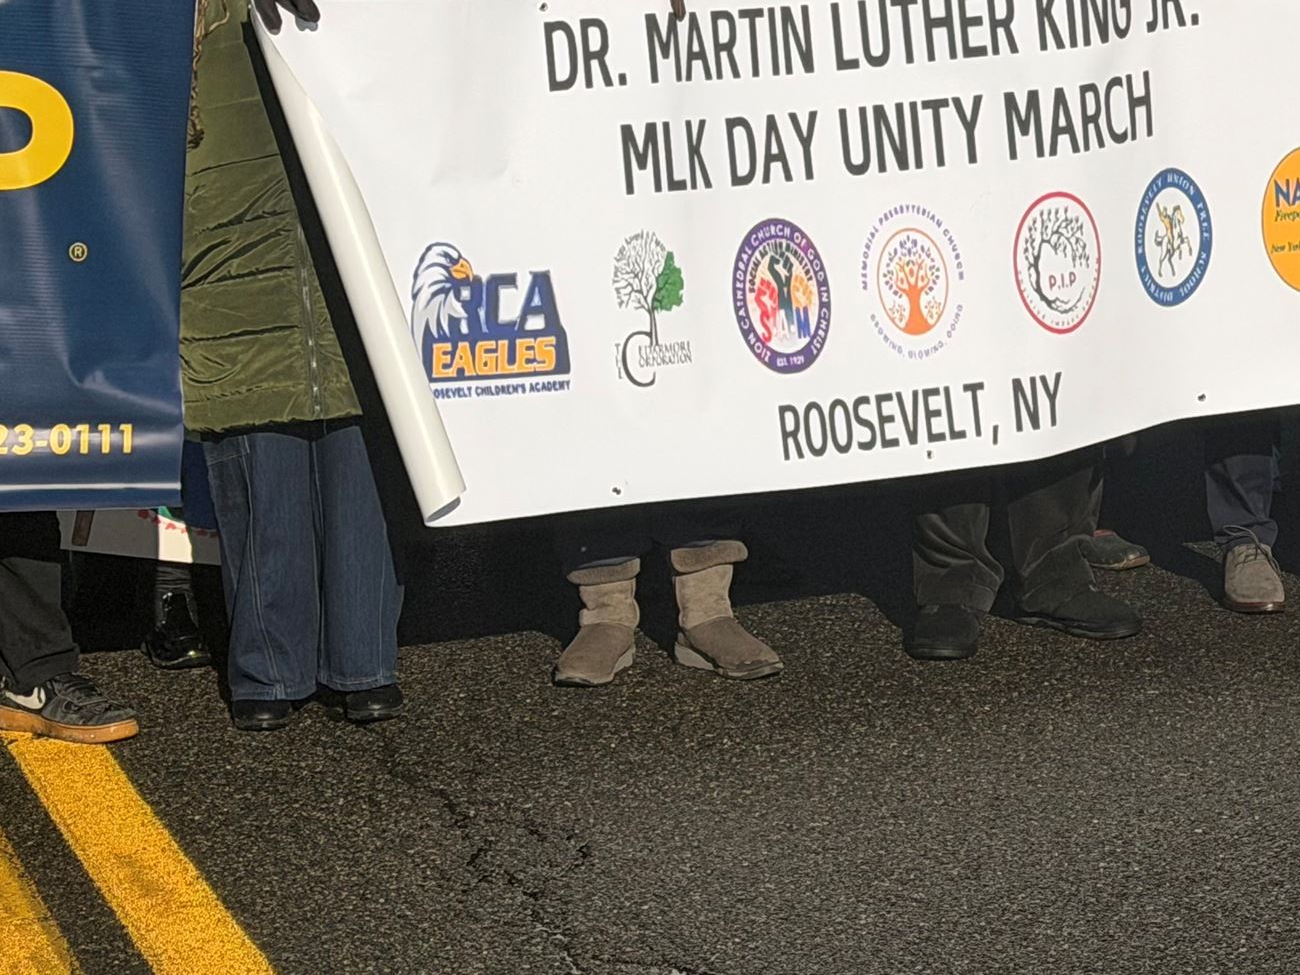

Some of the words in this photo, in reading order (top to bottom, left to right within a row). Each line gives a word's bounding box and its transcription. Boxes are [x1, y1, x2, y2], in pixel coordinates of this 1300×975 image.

[543, 16, 628, 91] DR.
[646, 5, 813, 85] MARTIN
[620, 119, 713, 194] MLK
[727, 111, 818, 188] DAY
[838, 94, 984, 176] UNITY
[1004, 70, 1154, 161] MARCH
[1166, 172, 1195, 196] UNION
[751, 224, 790, 247] CHURCH
[794, 232, 808, 248] OF
[807, 249, 824, 283] GOD
[453, 270, 562, 333] RCA
[820, 286, 829, 302] IN
[432, 336, 556, 378] EAGLES
[747, 332, 771, 363] ZION
[433, 386, 472, 399] OSEVELT
[475, 383, 527, 397] CHILDREN'S
[529, 380, 571, 393] ACADEMY
[778, 381, 999, 461] ROOSEVELT,
[1012, 372, 1062, 433] NY
